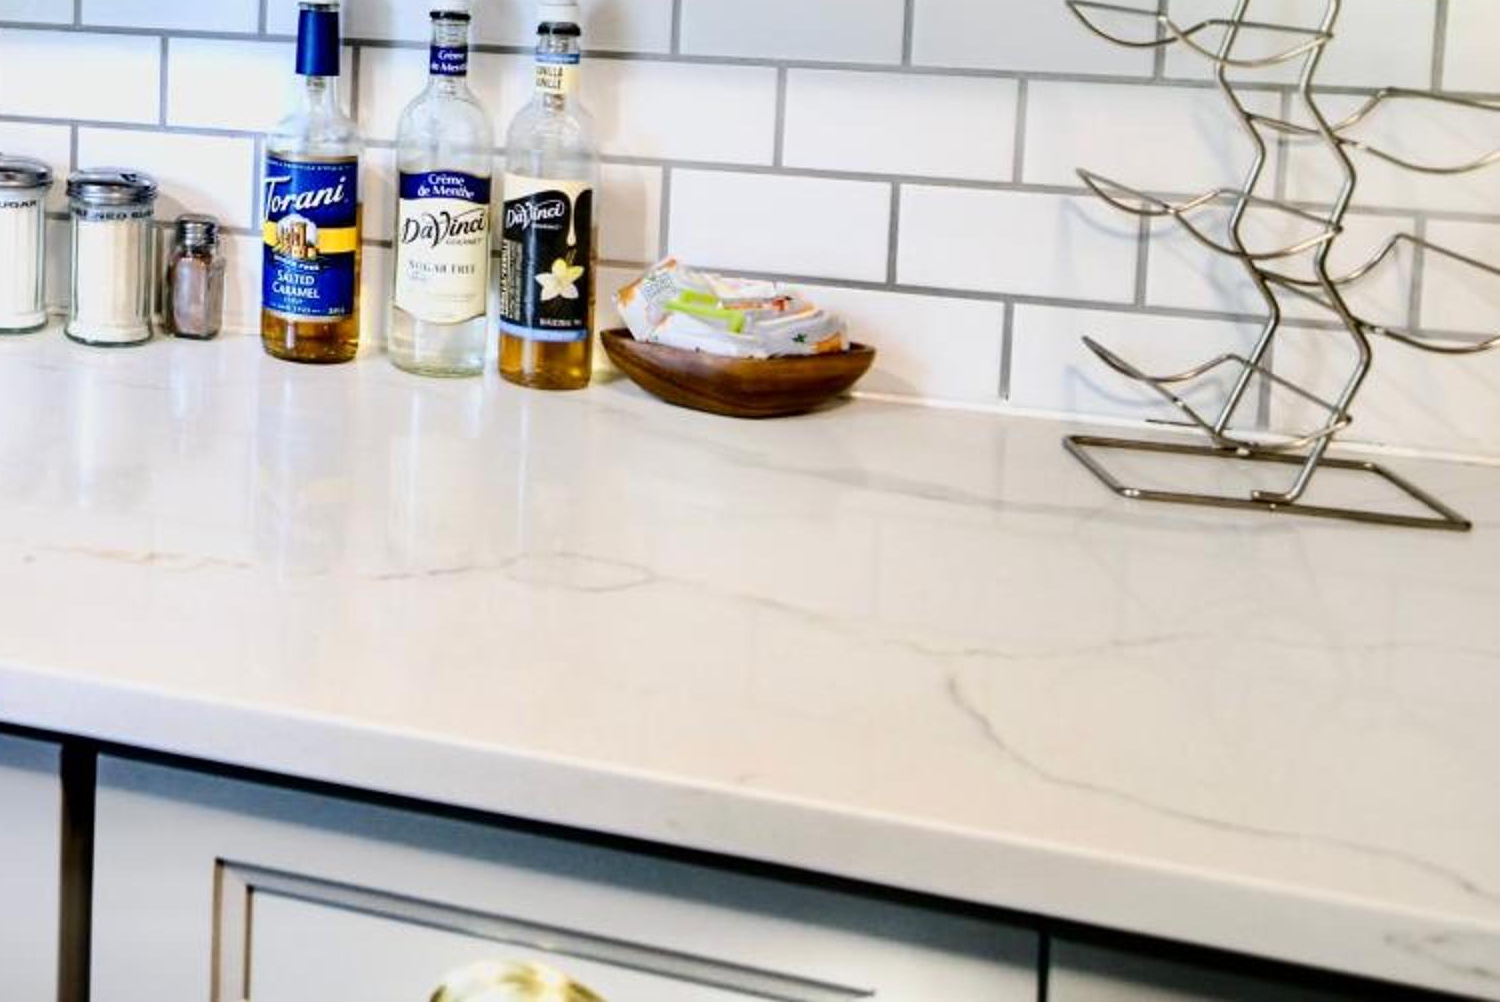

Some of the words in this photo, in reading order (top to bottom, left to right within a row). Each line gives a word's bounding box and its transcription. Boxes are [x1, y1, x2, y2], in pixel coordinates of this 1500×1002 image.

[427, 173, 465, 186] Crème
[262, 176, 346, 221] Torani
[417, 185, 431, 197] de
[432, 185, 475, 199] Menthe
[505, 199, 565, 230] DaVinci
[402, 207, 485, 248] DaVinci
[277, 269, 315, 286] SALTED
[271, 281, 321, 299] CARAMEL
